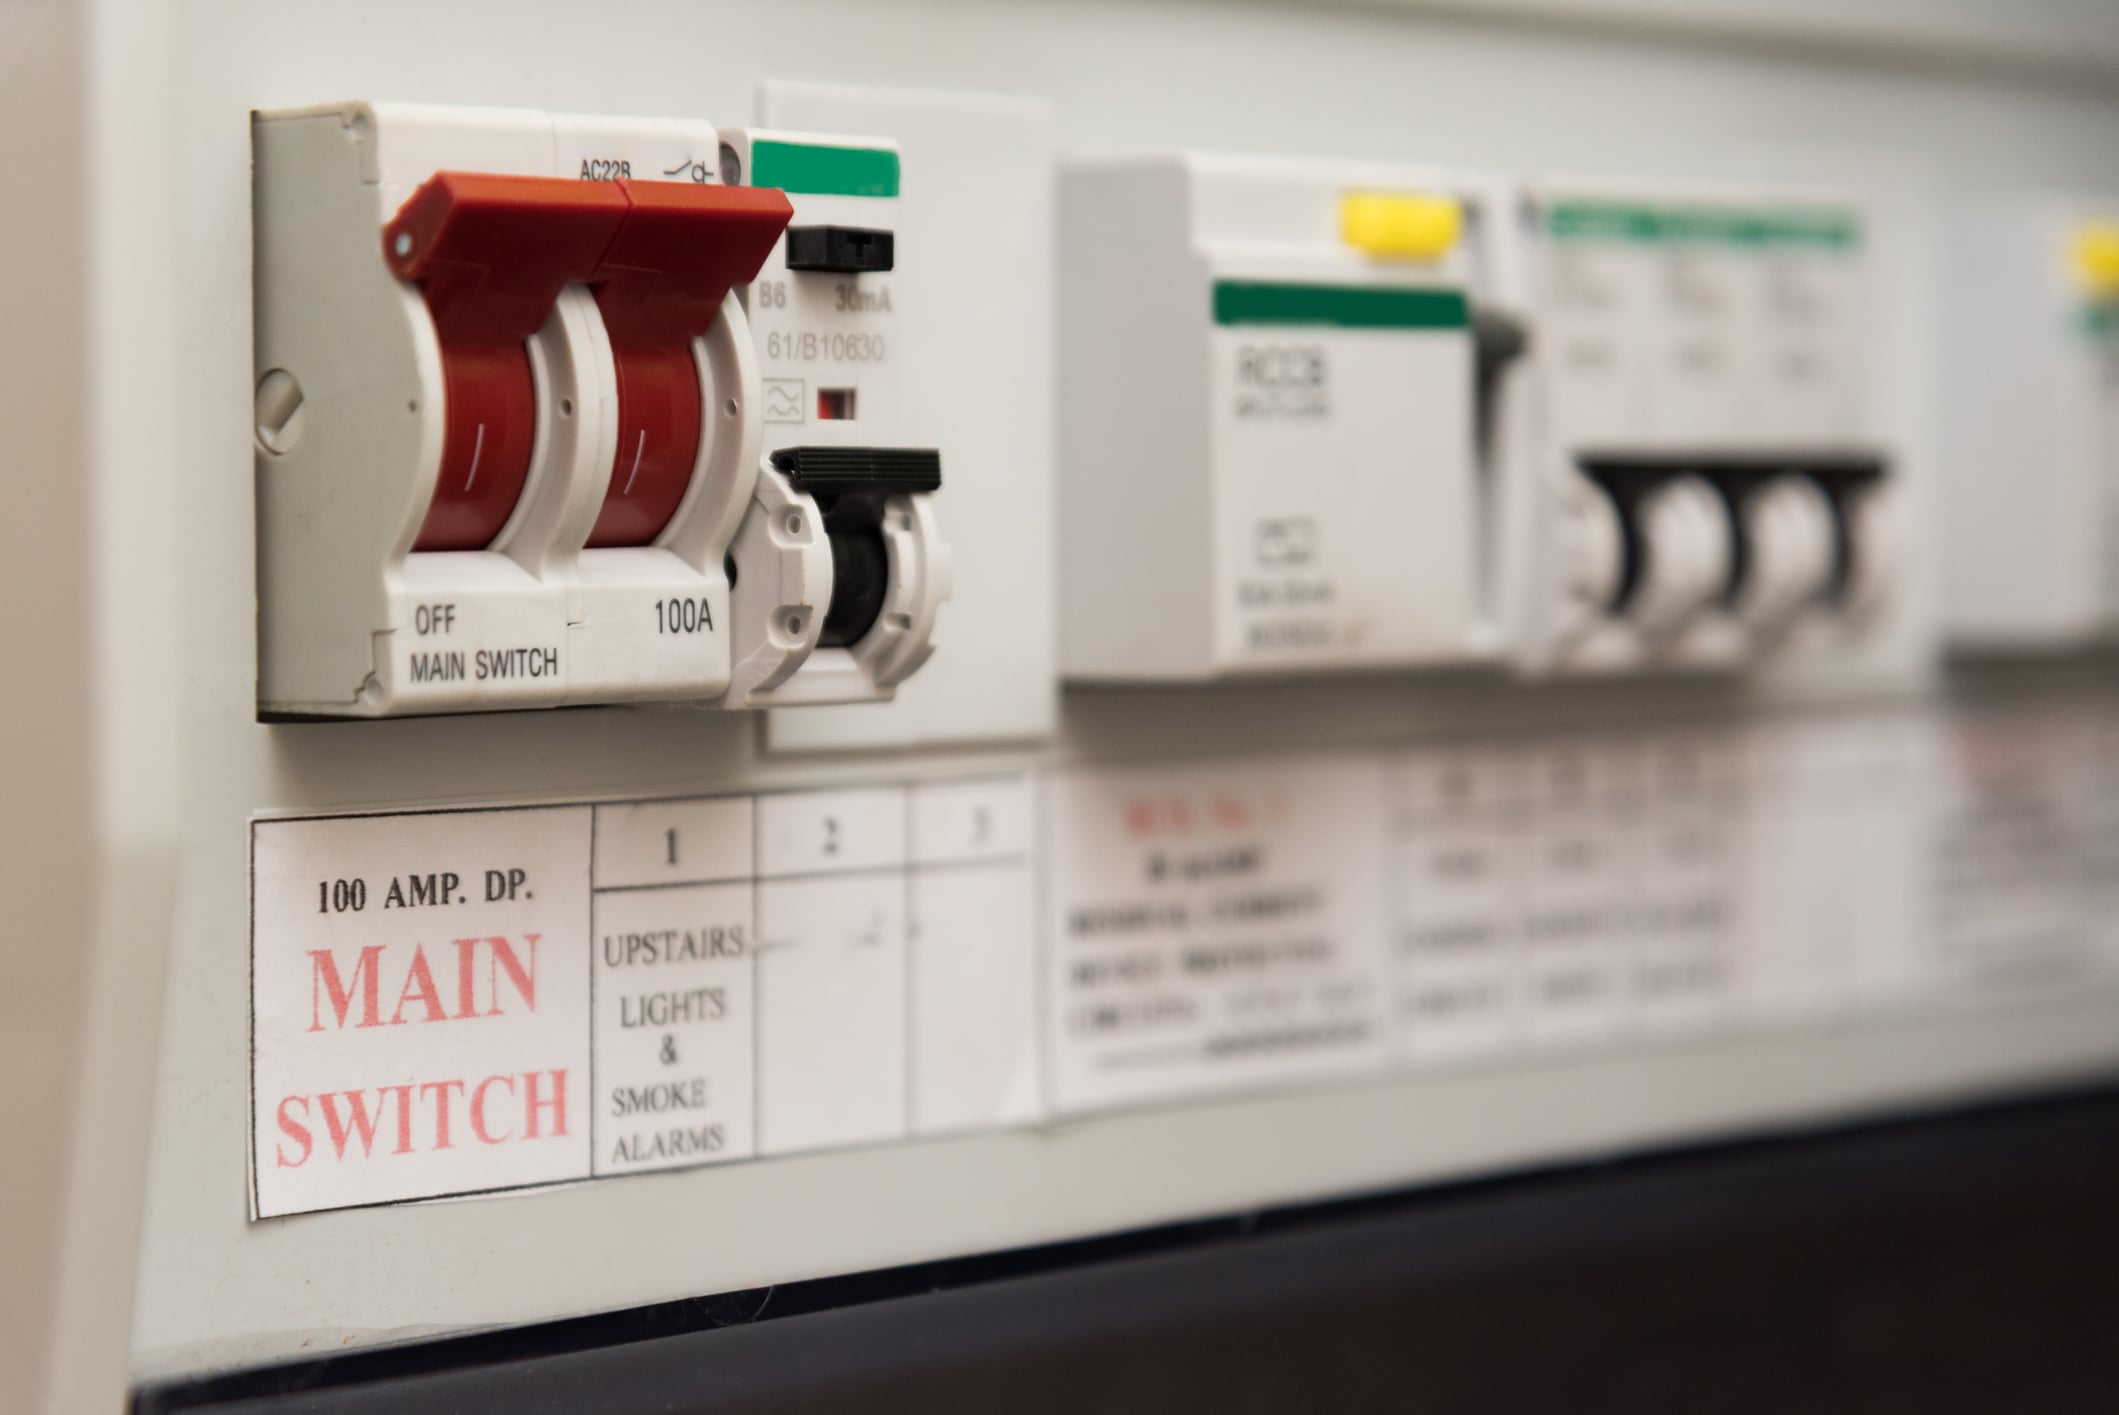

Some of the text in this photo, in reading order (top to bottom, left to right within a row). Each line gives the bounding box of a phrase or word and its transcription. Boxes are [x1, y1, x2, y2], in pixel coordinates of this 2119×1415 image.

[580, 158, 631, 182] AC22B
[758, 280, 892, 312] B6 30mA
[767, 331, 885, 361] 61/B10630
[415, 604, 456, 635] OFF
[655, 598, 714, 634] 100A
[410, 648, 558, 682] MAIN SWITCH
[664, 827, 678, 866] 1
[820, 816, 839, 857] 2
[318, 868, 533, 914] 100 AMP. DP.
[603, 925, 745, 968] UPSTAIRS
[305, 933, 542, 1032] MAIN
[620, 986, 727, 1029] LIGHTS
[659, 1033, 678, 1065] &
[611, 1078, 706, 1118] SMOKE
[276, 1068, 569, 1168] SWITCH
[610, 1123, 725, 1165] ALARMS
